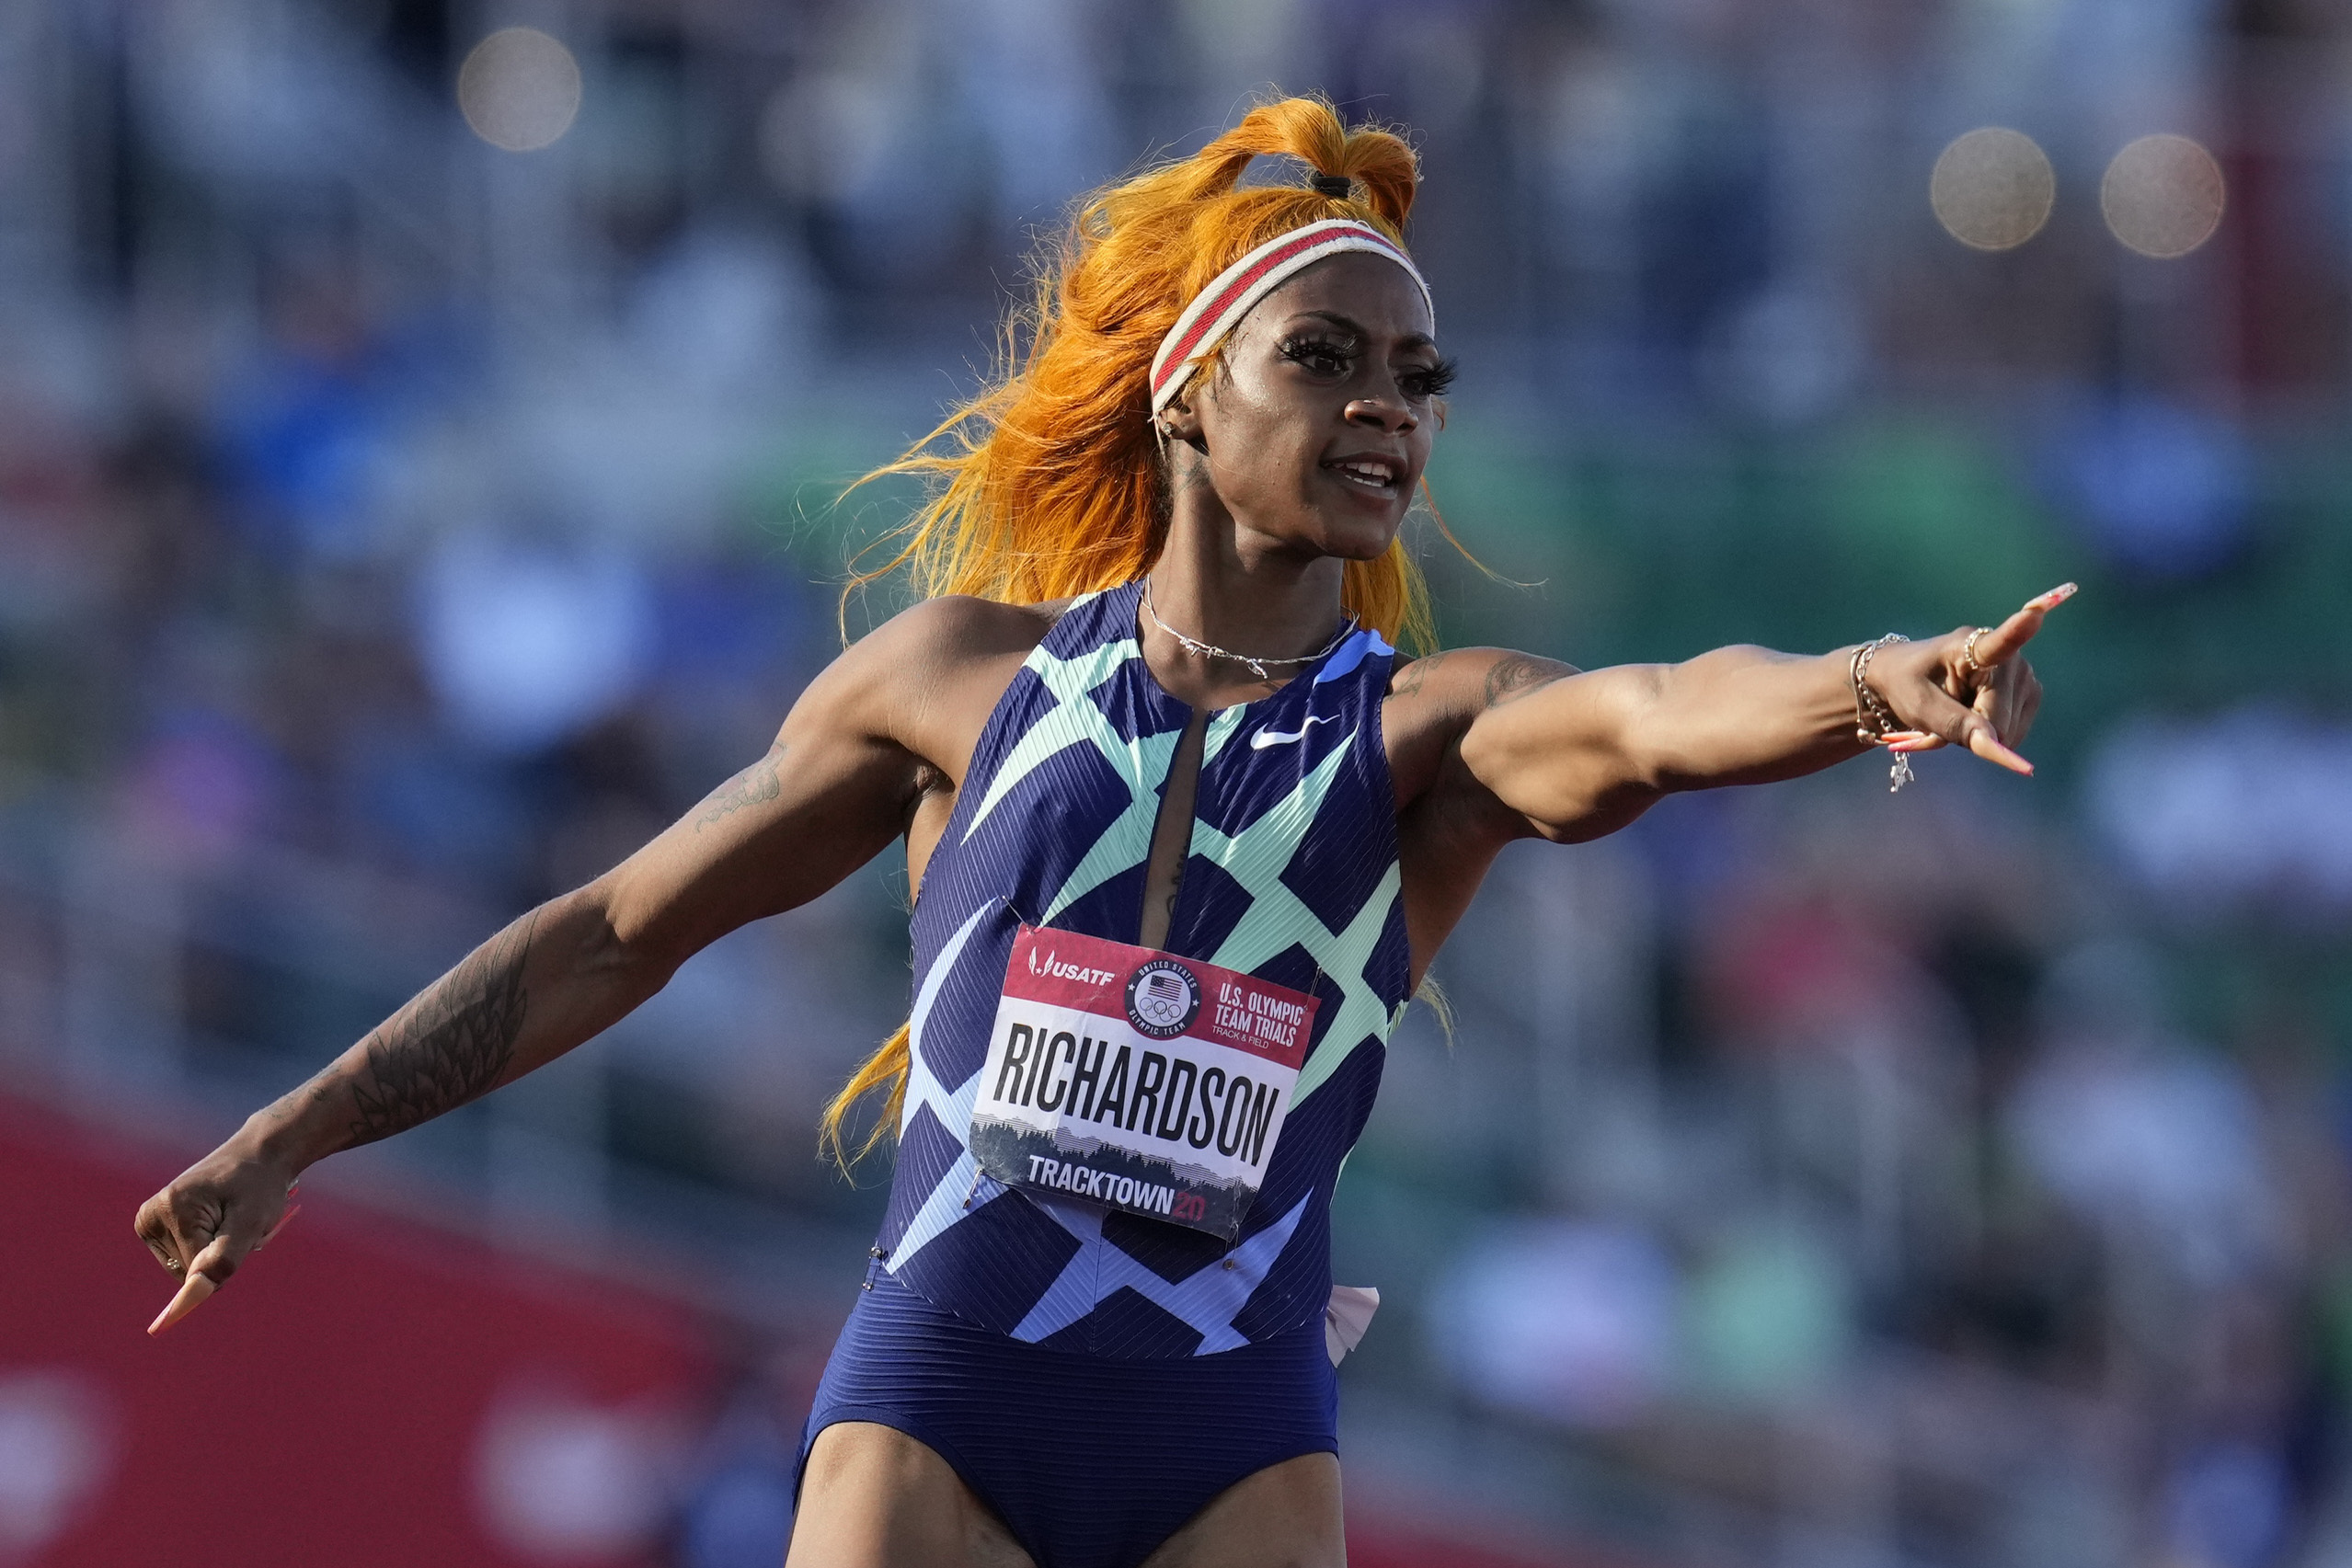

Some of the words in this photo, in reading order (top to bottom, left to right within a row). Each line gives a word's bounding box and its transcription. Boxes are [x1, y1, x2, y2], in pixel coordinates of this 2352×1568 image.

[1051, 961, 1116, 987] USATF
[1138, 960, 1169, 977] UNITED
[1172, 963, 1198, 989] STATES
[1219, 982, 1244, 1009] U.S.
[1247, 991, 1304, 1026] OLYMPIC
[1128, 1009, 1160, 1036] OLYMPIC
[1163, 1022, 1187, 1036] TEAM
[1212, 1024, 1240, 1042] TRACK
[1241, 1034, 1247, 1042] &
[1248, 1036, 1269, 1049] FIELD
[1214, 1003, 1253, 1034] TEAM
[1255, 1015, 1297, 1047] TRIALS
[992, 1022, 1279, 1167] RICHARDSON
